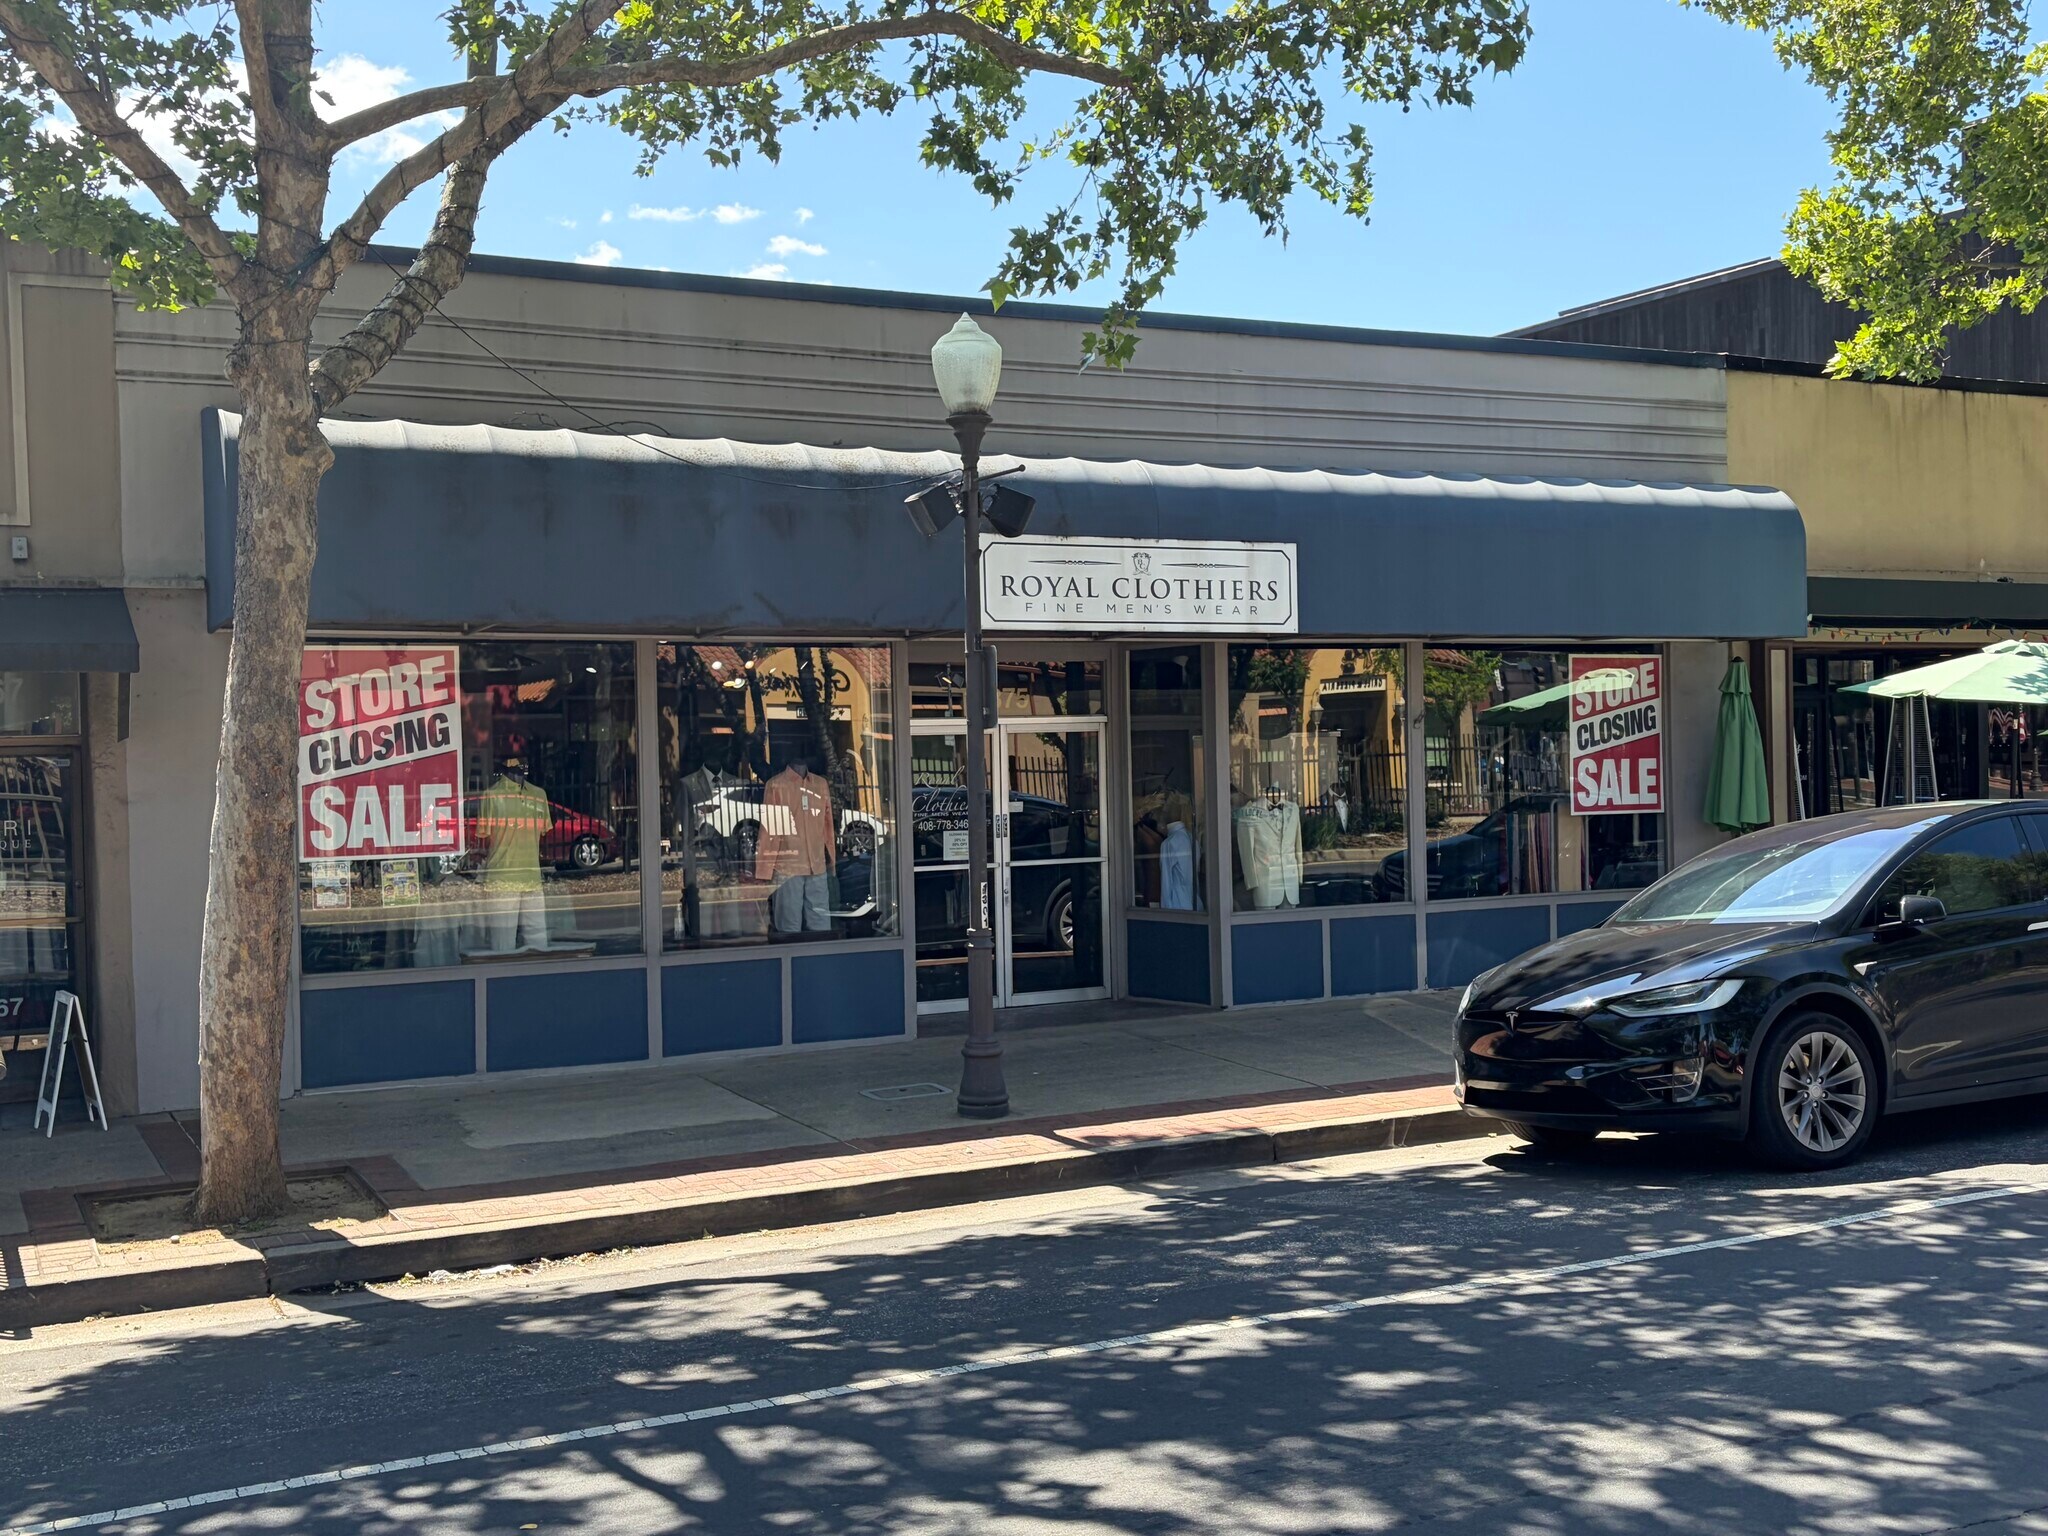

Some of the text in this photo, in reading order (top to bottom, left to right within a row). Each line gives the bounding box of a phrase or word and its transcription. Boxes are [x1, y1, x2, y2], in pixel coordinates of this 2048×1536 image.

[1000, 575, 1279, 601] ROYAL CLOTHIERS
[1025, 602, 1258, 615] FINE MEN'S WEAR
[305, 656, 449, 729] STORE
[998, 688, 1030, 709] 75
[1575, 662, 1656, 716] STORE
[308, 712, 451, 776] CLOSING
[1576, 704, 1657, 751] CLOSING
[1577, 758, 1658, 807] SALE
[310, 784, 454, 850] SALE
[918, 819, 969, 831] 408-778-346
